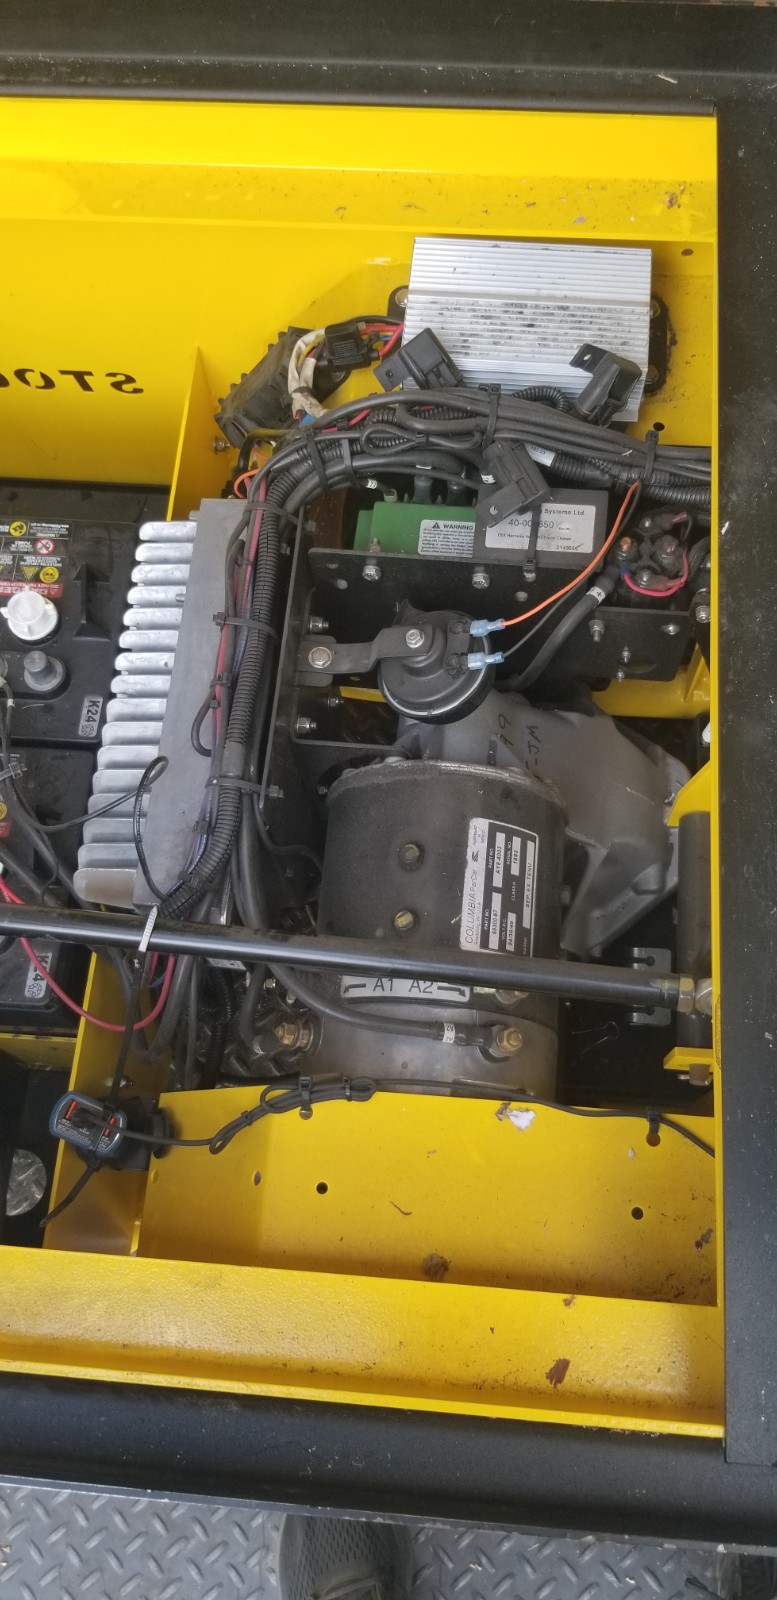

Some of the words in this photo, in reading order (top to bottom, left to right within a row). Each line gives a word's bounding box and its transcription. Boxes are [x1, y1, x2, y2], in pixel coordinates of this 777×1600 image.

[443, 523, 474, 531] WARNING
[85, 700, 101, 723] K24
[469, 868, 478, 893] ParCar
[465, 893, 477, 944] COLUMBIA
[373, 977, 394, 992] A1
[408, 979, 434, 994] A2
